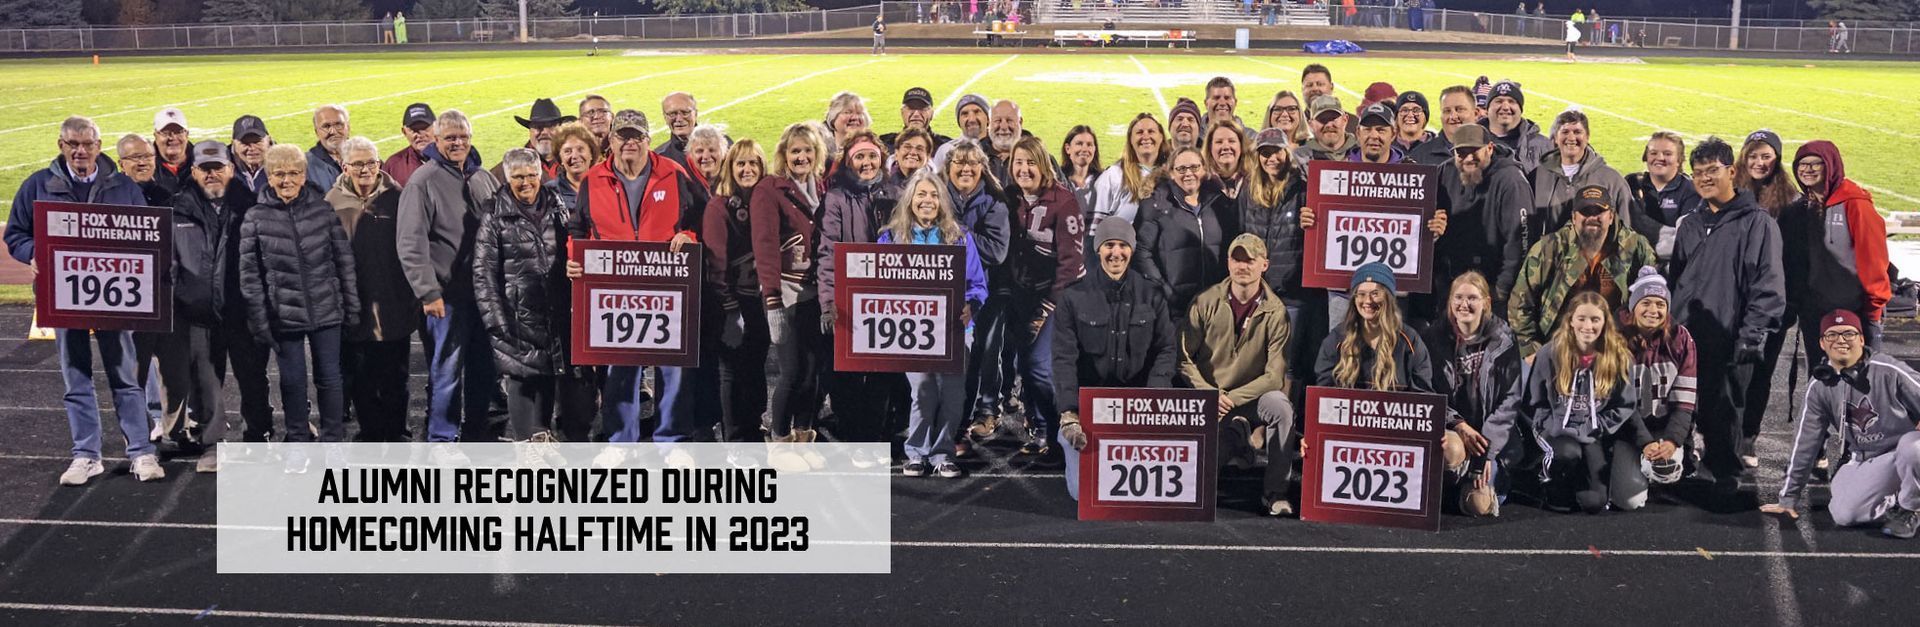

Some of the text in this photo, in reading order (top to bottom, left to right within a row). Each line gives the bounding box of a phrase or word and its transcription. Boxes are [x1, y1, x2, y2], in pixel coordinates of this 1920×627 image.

[1352, 170, 1426, 188] FOX VALLEY
[653, 190, 666, 202] W
[1350, 186, 1425, 200] LUTHERAN HS
[81, 213, 160, 230] FOX VALLEY
[1027, 206, 1053, 243] L
[1340, 217, 1408, 235] CLASS OF
[82, 227, 160, 242] LUTHERAN HS
[616, 250, 689, 265] FOX VALLEY
[878, 253, 954, 268] FOX VALLEY
[1336, 235, 1407, 269] 1998
[67, 257, 139, 274] CLASS OF
[616, 264, 689, 278] LUTHERAN HS
[878, 268, 954, 280] LUTHERAN HS
[65, 275, 141, 307] 1963
[602, 296, 669, 311] CLASS OF
[865, 300, 934, 316] CLASS OF
[601, 312, 670, 344] 1973
[863, 317, 936, 351] 1983
[1126, 398, 1206, 413] FOX VALLEY
[1353, 400, 1434, 418] FOX VALLEY
[1126, 413, 1206, 426] LUTHERAN HS
[1352, 415, 1433, 432] LUTHERAN HS
[1112, 446, 1184, 462] CLASS OF
[1337, 448, 1410, 468] CLASS OF
[1110, 464, 1183, 497] 2013
[1333, 466, 1408, 504] 2023
